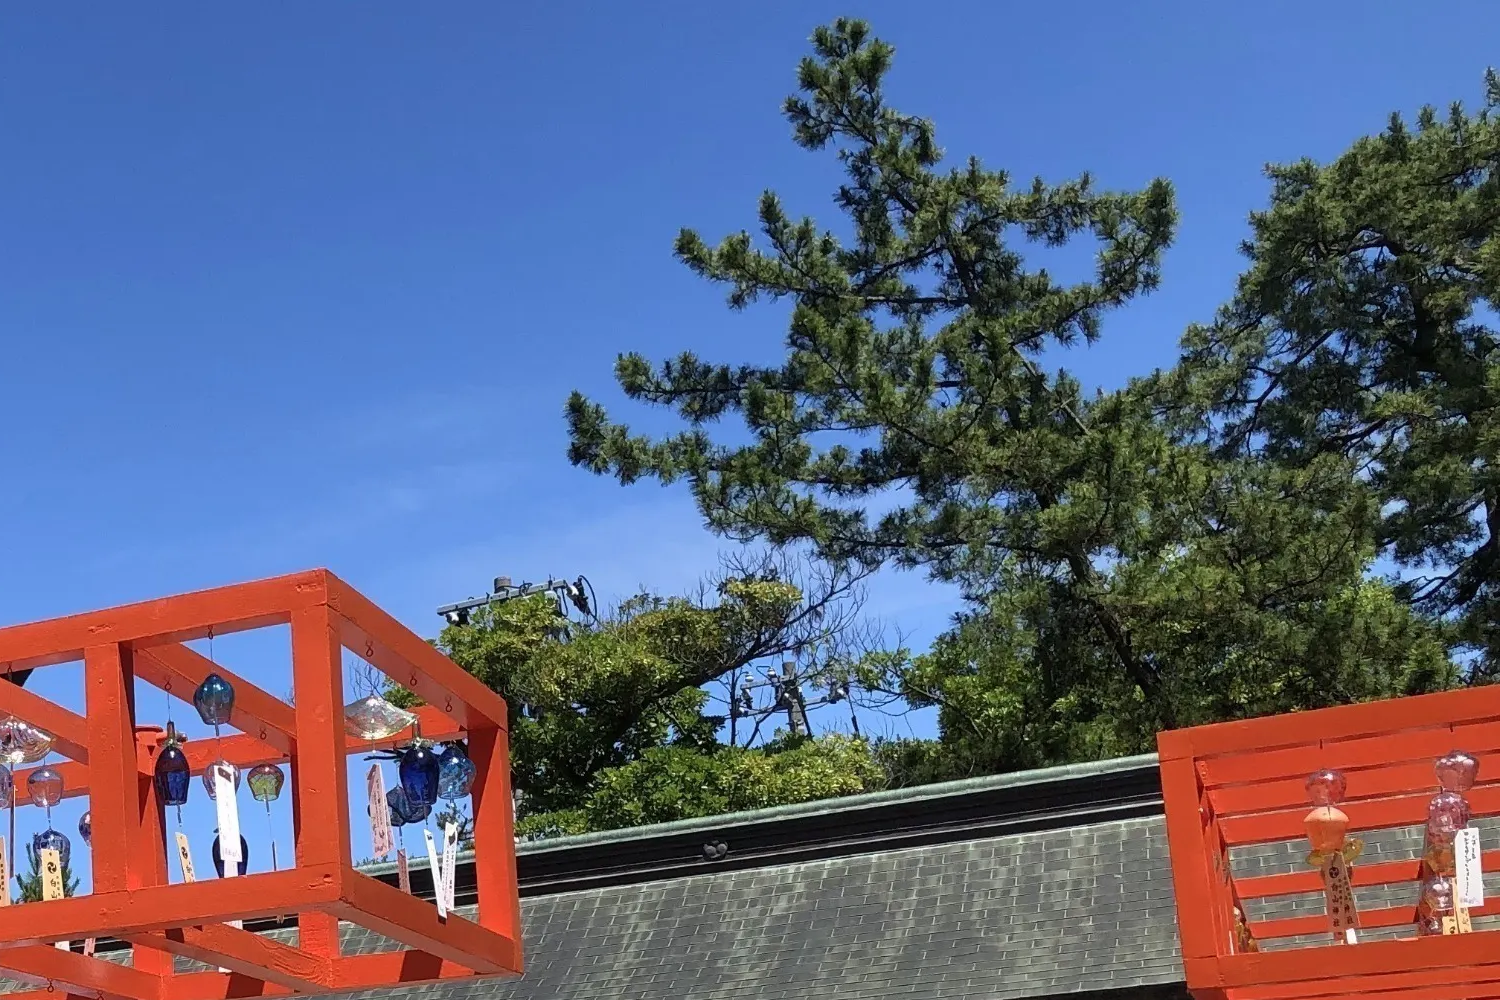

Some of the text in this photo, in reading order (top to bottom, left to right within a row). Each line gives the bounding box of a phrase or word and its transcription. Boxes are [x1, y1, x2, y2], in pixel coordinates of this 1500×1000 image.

[50, 878, 58, 899] 白山
[1331, 883, 1340, 928] 白山神社
